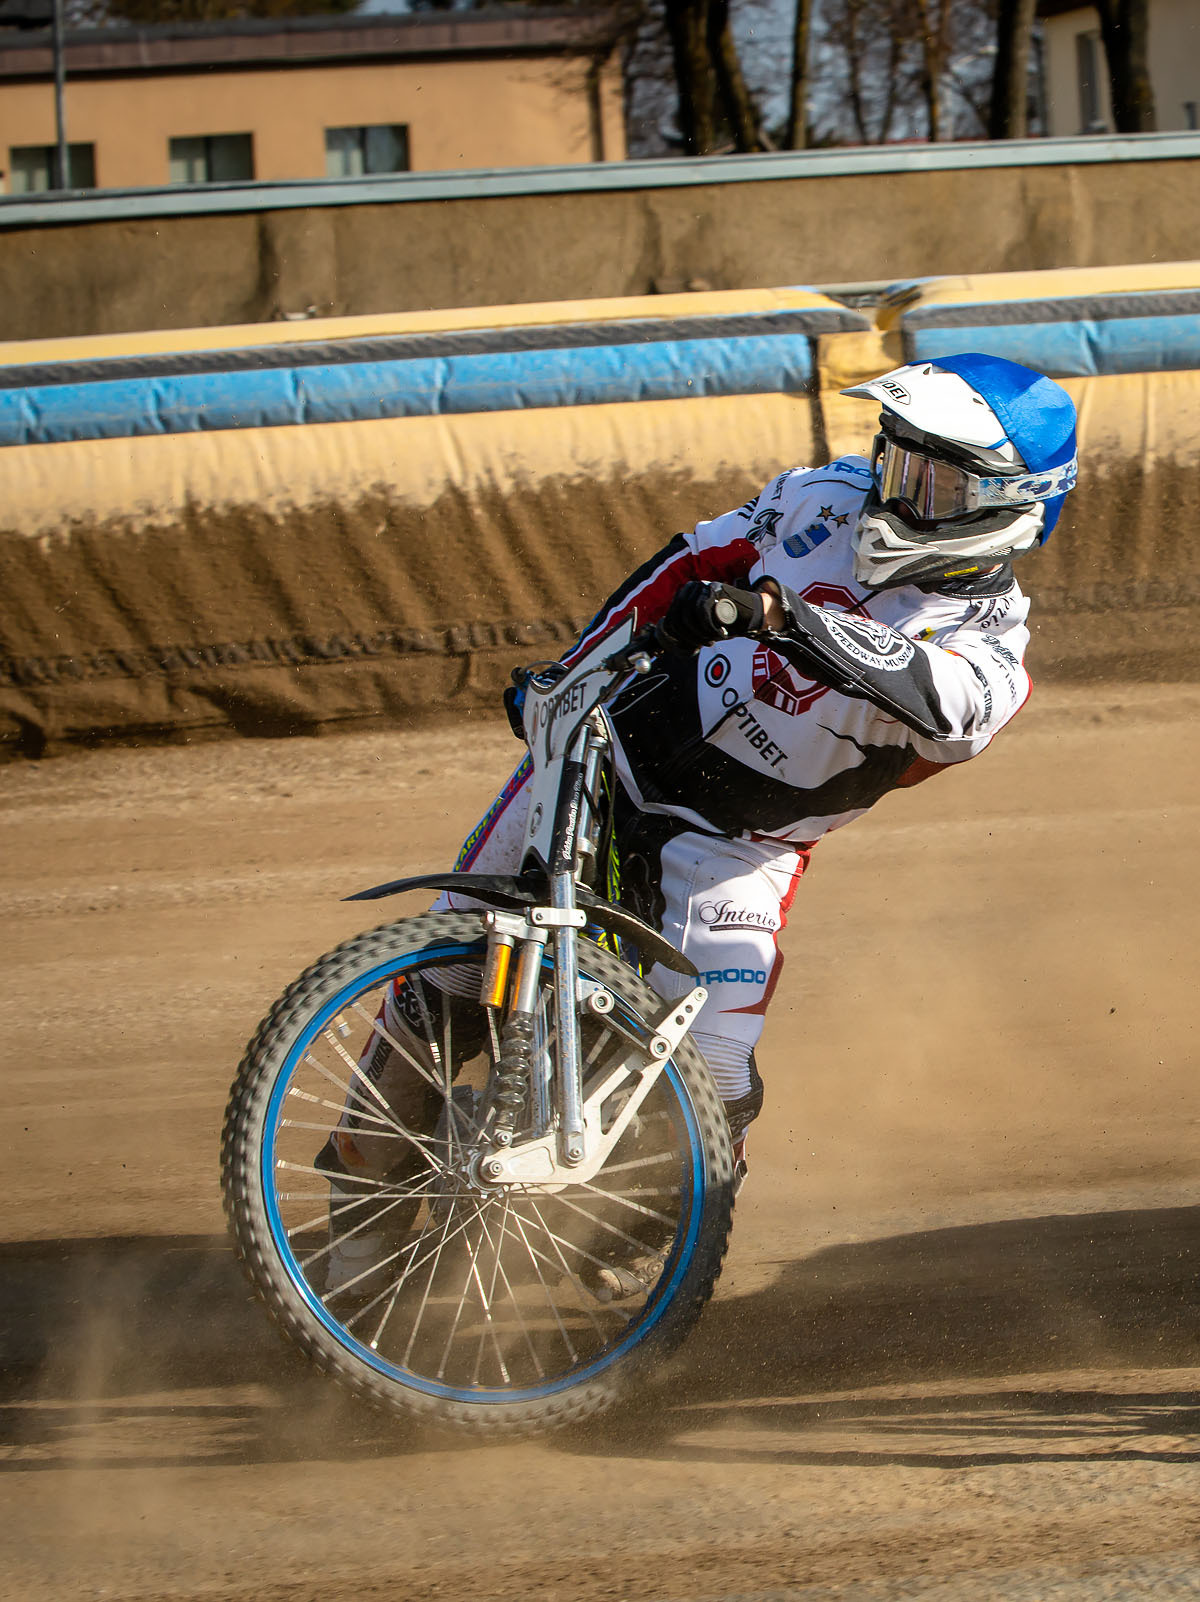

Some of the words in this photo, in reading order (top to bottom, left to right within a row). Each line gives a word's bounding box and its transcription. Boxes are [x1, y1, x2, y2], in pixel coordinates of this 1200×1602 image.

[879, 381, 908, 400] OEI
[829, 625, 882, 666] SPEEDWAY
[721, 687, 789, 769] OPTIBET
[698, 899, 776, 928] Interio
[690, 968, 767, 987] TRODO
